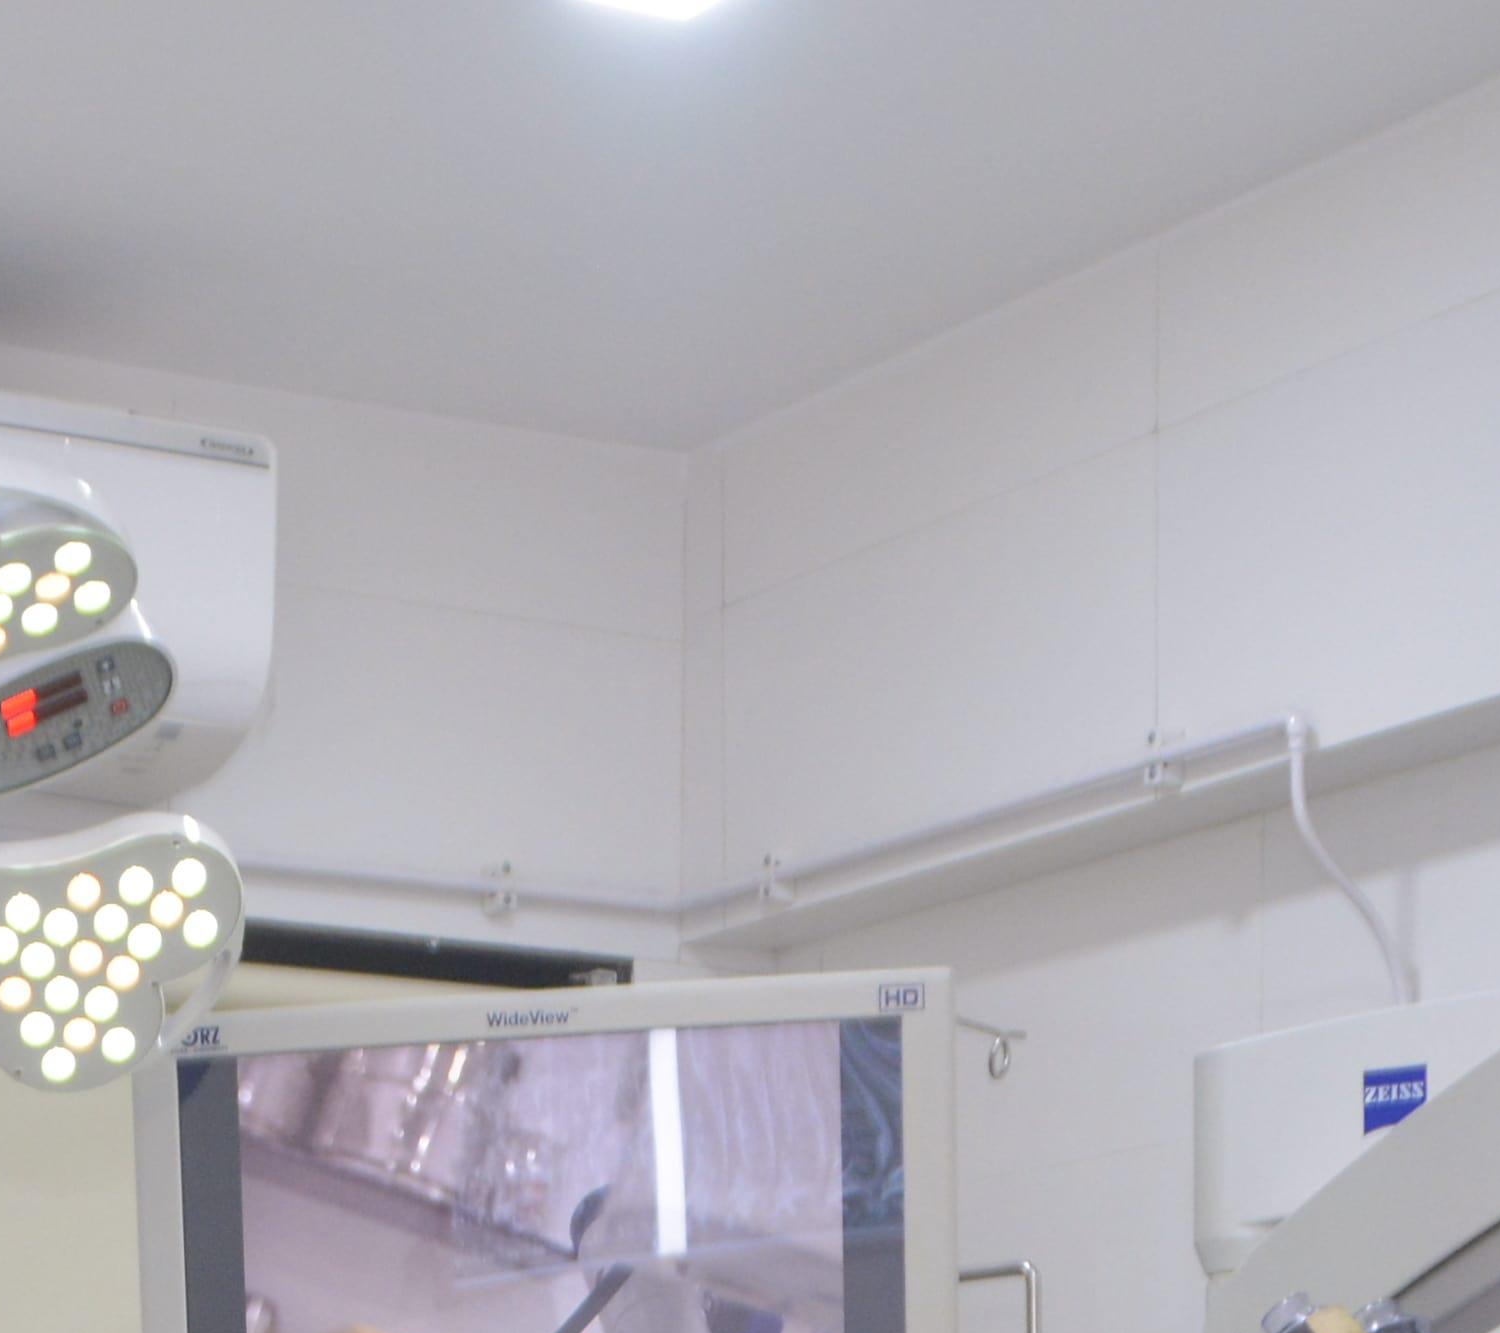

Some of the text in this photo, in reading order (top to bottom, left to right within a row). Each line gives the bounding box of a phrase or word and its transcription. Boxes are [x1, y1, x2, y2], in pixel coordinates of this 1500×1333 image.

[885, 988, 919, 1007] HD
[486, 1009, 569, 1028] WideView
[1364, 1080, 1425, 1104] ZEISS
